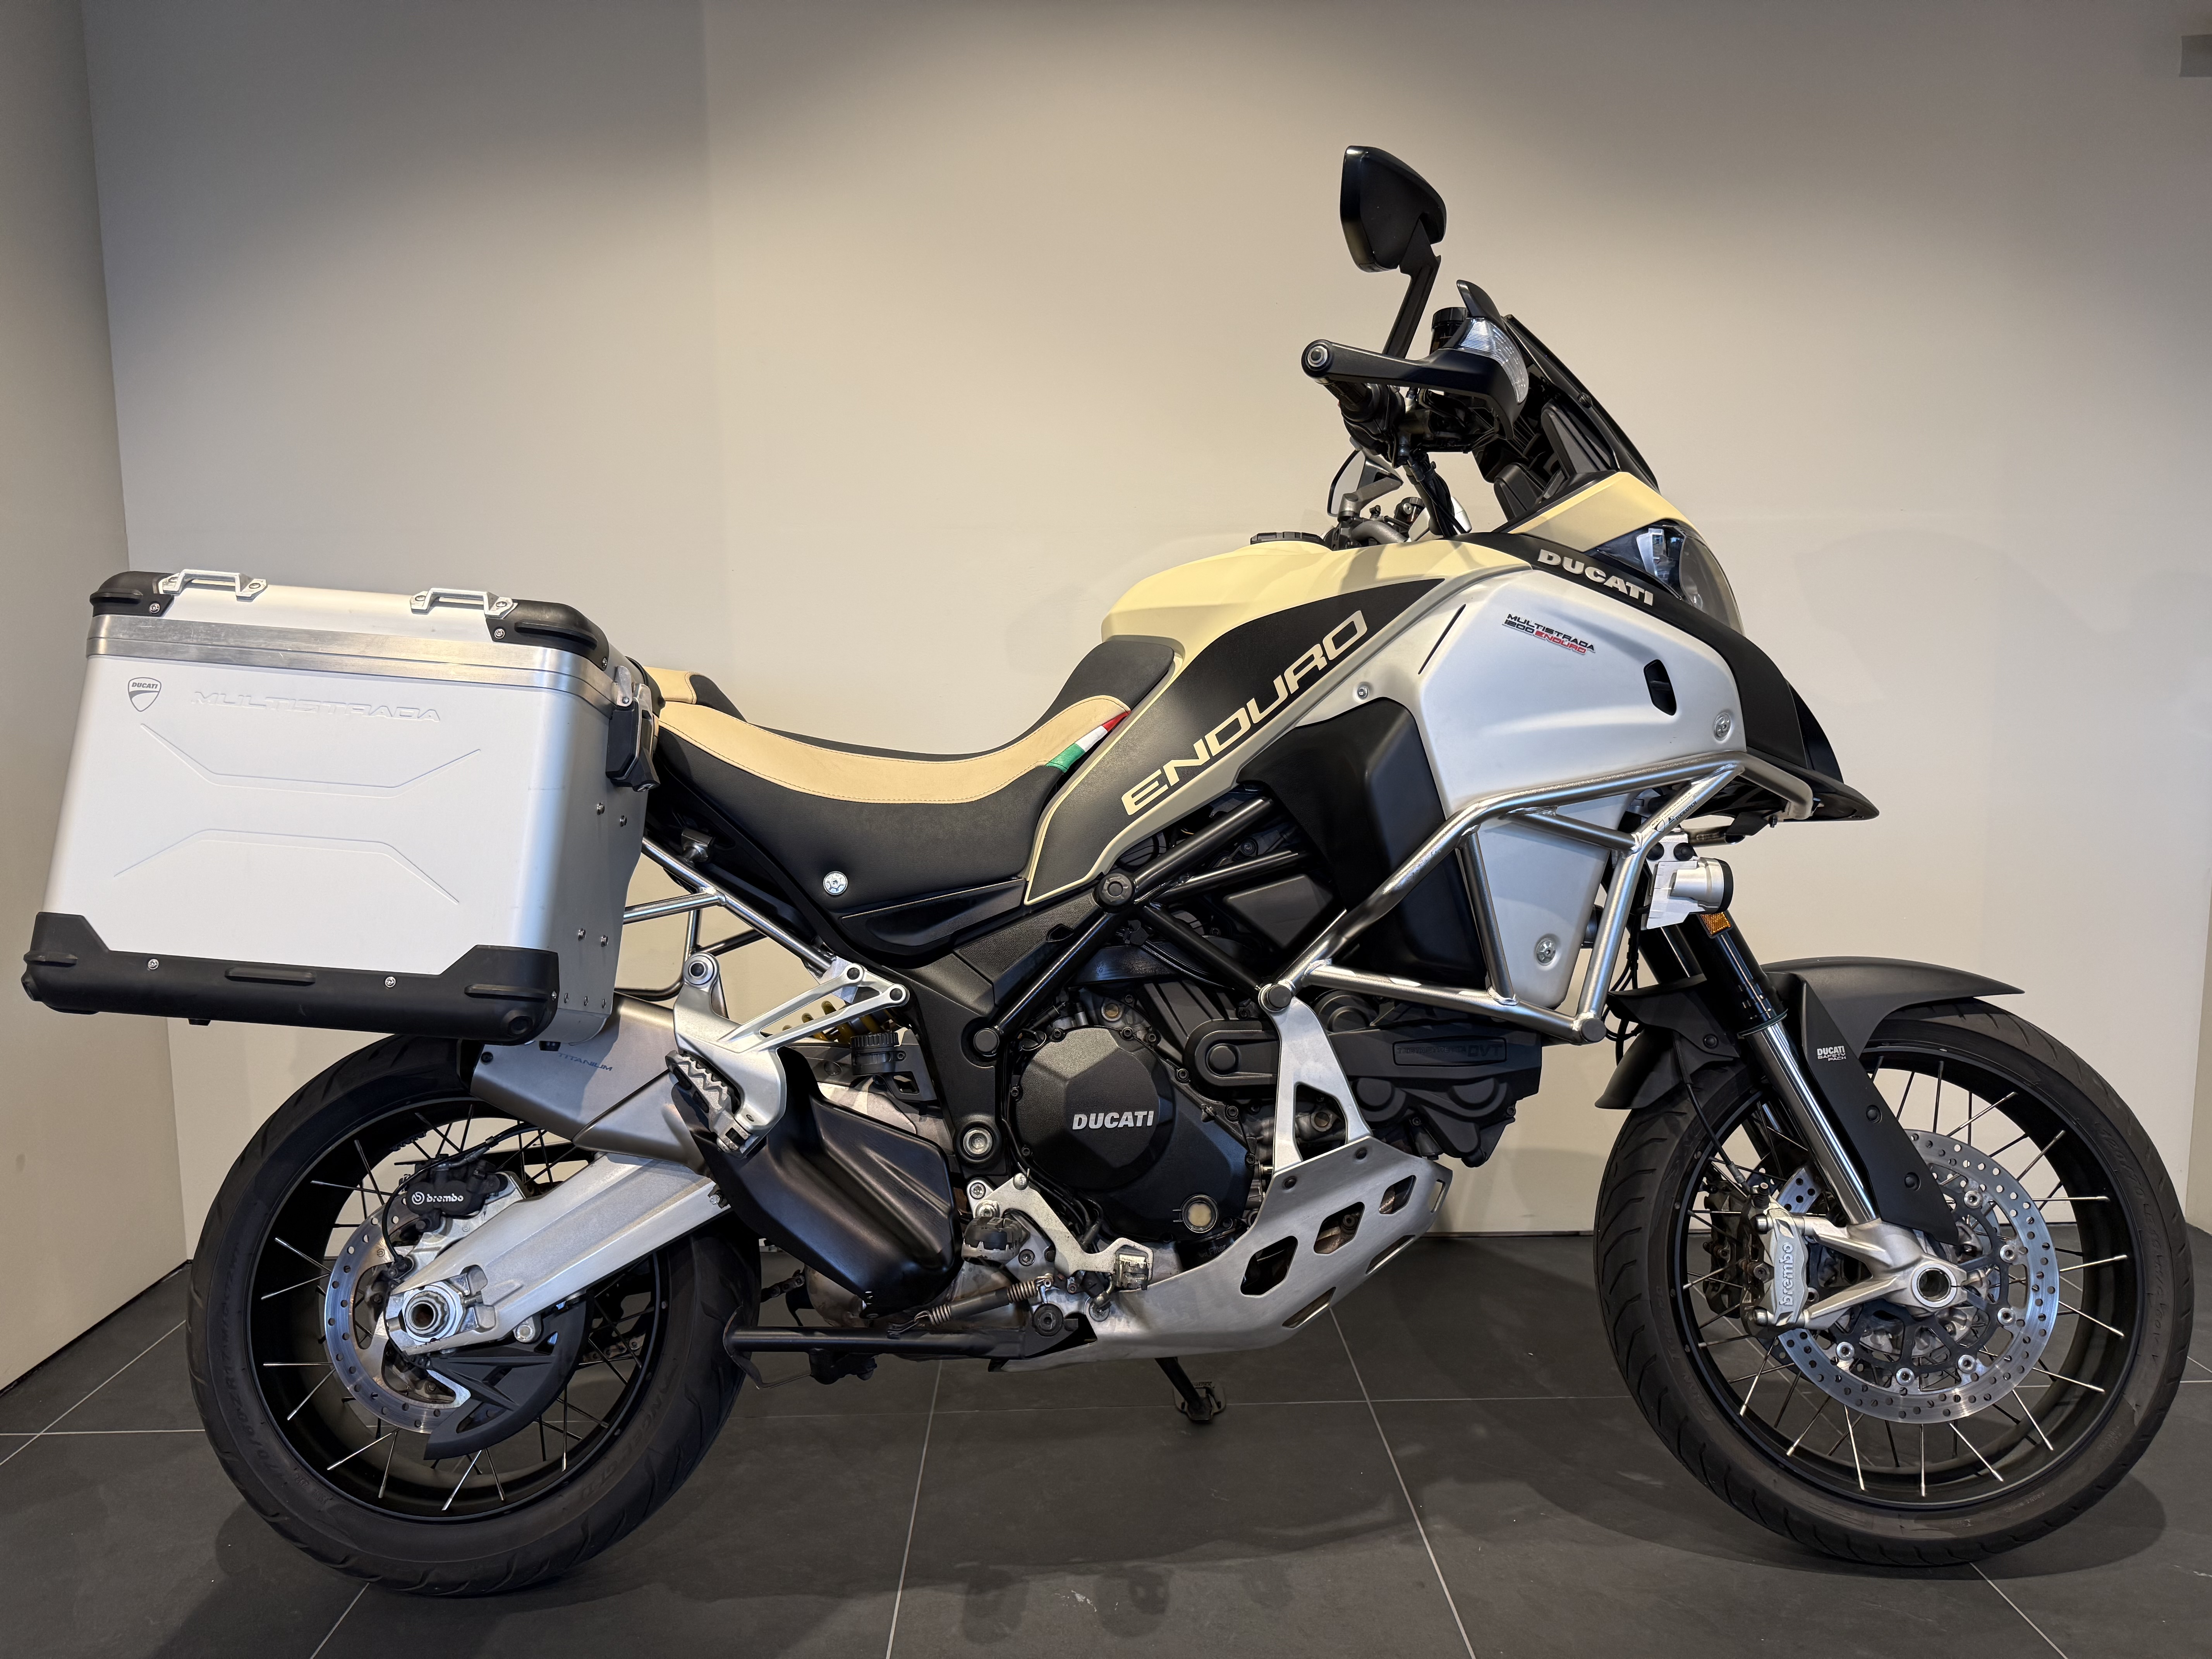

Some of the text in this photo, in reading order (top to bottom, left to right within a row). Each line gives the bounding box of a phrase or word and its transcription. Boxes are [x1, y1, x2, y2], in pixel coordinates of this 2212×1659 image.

[1537, 549, 1653, 606] DUCATI
[1504, 619, 1587, 654] 1200 ENDURO
[1507, 613, 1595, 651] MULTISTRADA
[191, 691, 440, 723] MULTISTRADA
[1121, 610, 1367, 816] ENDURO
[1675, 800, 1697, 821] TOURATECH
[558, 1052, 613, 1072] TITANIUM
[1467, 1044, 1503, 1058] DVT
[1817, 1046, 1845, 1056] DUCATI
[1072, 1111, 1154, 1130] DUCATI
[426, 1194, 464, 1203] brembo
[1779, 1242, 1793, 1307] brembo
